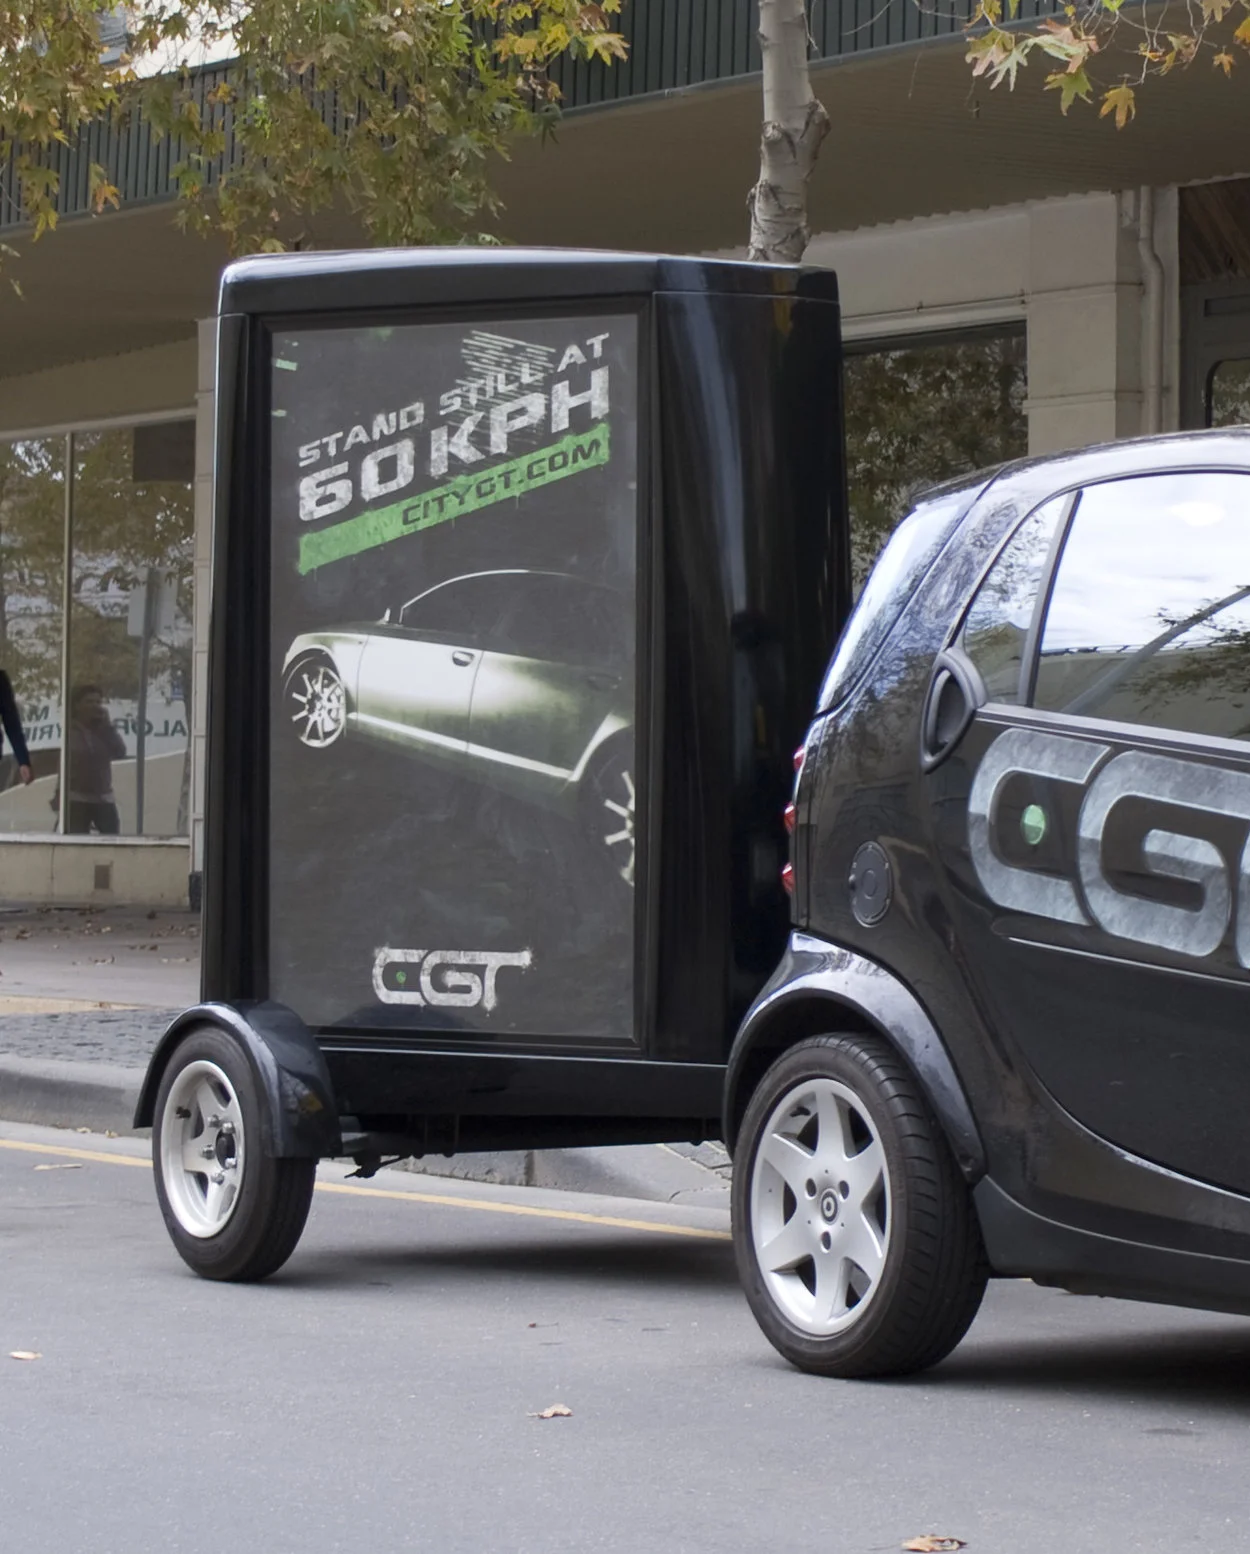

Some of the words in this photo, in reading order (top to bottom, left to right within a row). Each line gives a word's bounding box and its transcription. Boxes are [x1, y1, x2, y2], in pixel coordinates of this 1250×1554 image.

[299, 402, 425, 467] STAND
[440, 362, 545, 415] STILL
[557, 332, 610, 373] AT
[299, 438, 415, 521] 60
[430, 366, 610, 479] KPH
[402, 437, 602, 527] CITYGT.COM
